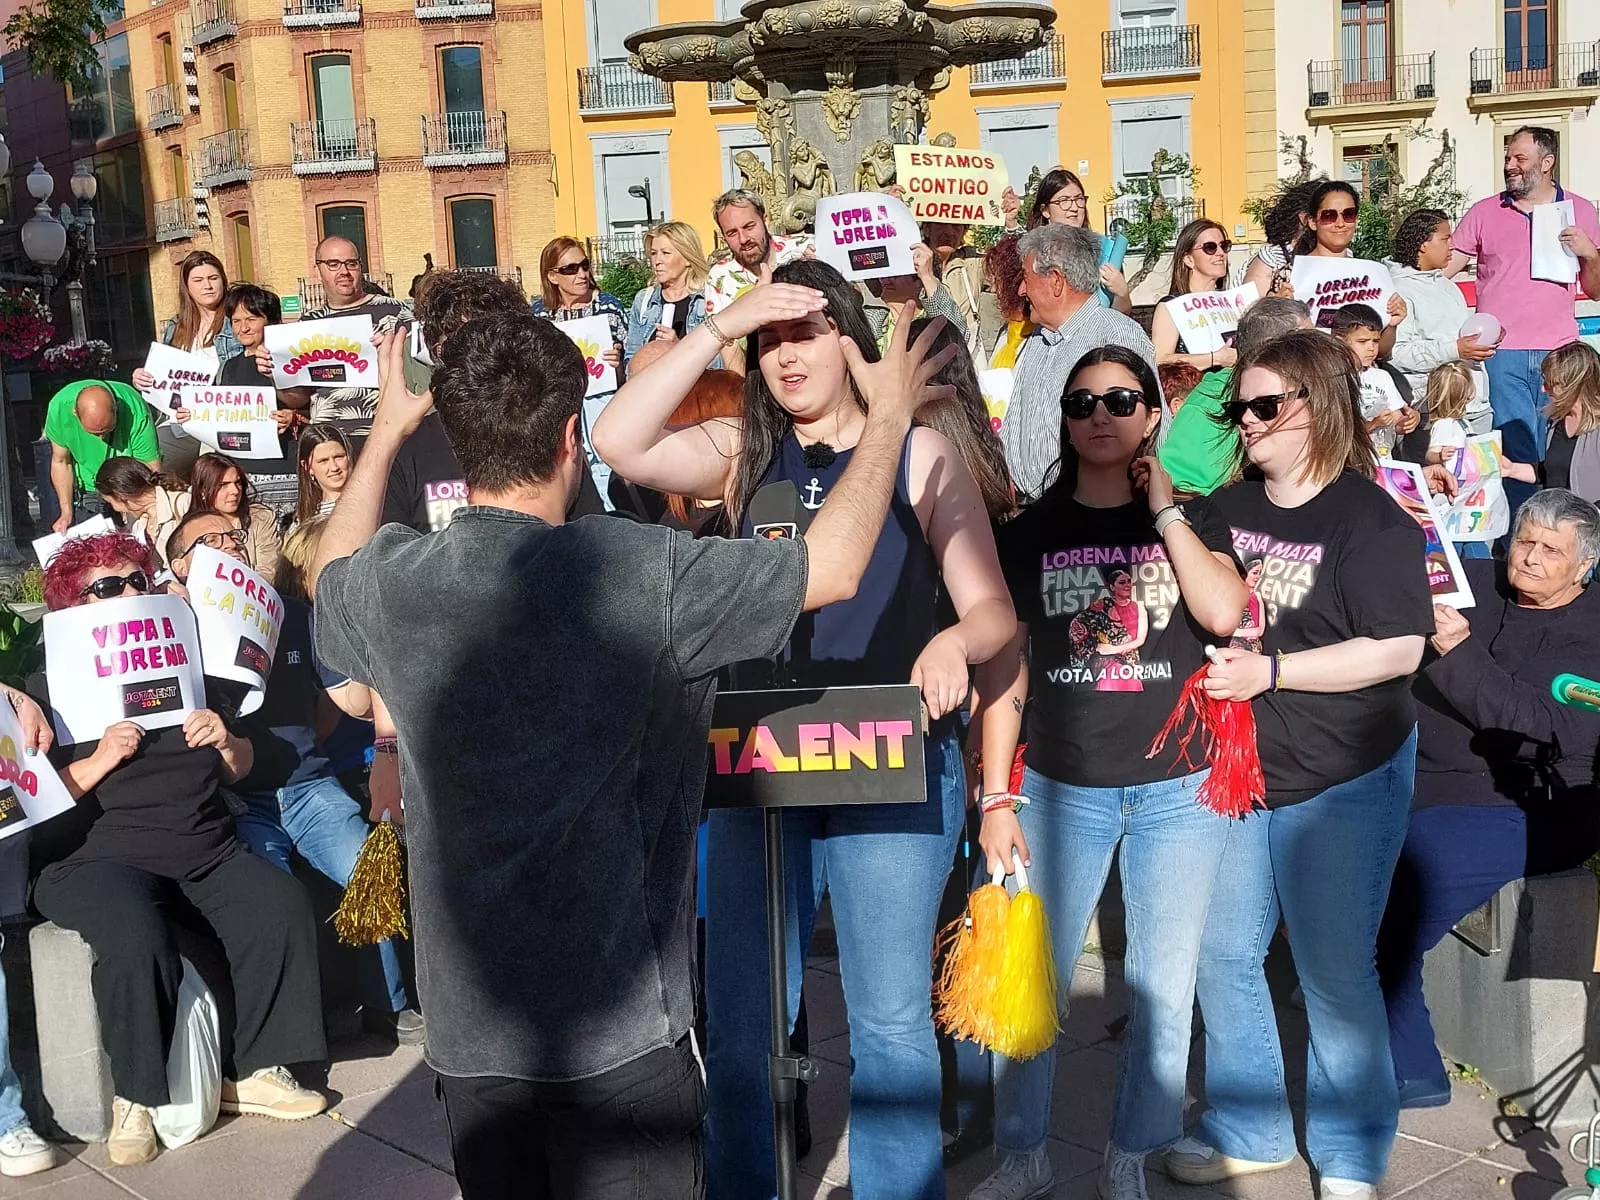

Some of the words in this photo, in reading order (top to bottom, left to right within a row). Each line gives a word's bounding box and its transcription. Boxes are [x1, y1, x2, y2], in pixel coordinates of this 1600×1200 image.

[911, 153, 994, 169] ESTAMOS
[909, 177, 988, 195] CONTIGO
[831, 207, 872, 226] VOTA
[915, 203, 985, 220] LORENA
[833, 224, 897, 245] LORENA
[1315, 275, 1369, 295] LORENA
[1183, 296, 1232, 312] LORENA
[168, 369, 210, 383] LORENA
[195, 391, 251, 406] LORENA
[256, 392, 264, 405] A
[1043, 547, 1127, 570] LORENA
[1268, 542, 1322, 563] MATA
[1043, 566, 1105, 593] FINA
[1131, 562, 1177, 583] JOT
[203, 587, 235, 614] LA
[1152, 607, 1170, 630] 3
[92, 618, 159, 649] VOTA
[161, 616, 176, 640] A
[93, 642, 189, 678] LORENA
[1047, 668, 1094, 683] VOTA
[1096, 669, 1107, 681] A
[125, 686, 176, 704] JOTALENT
[708, 720, 914, 774] TALENT
